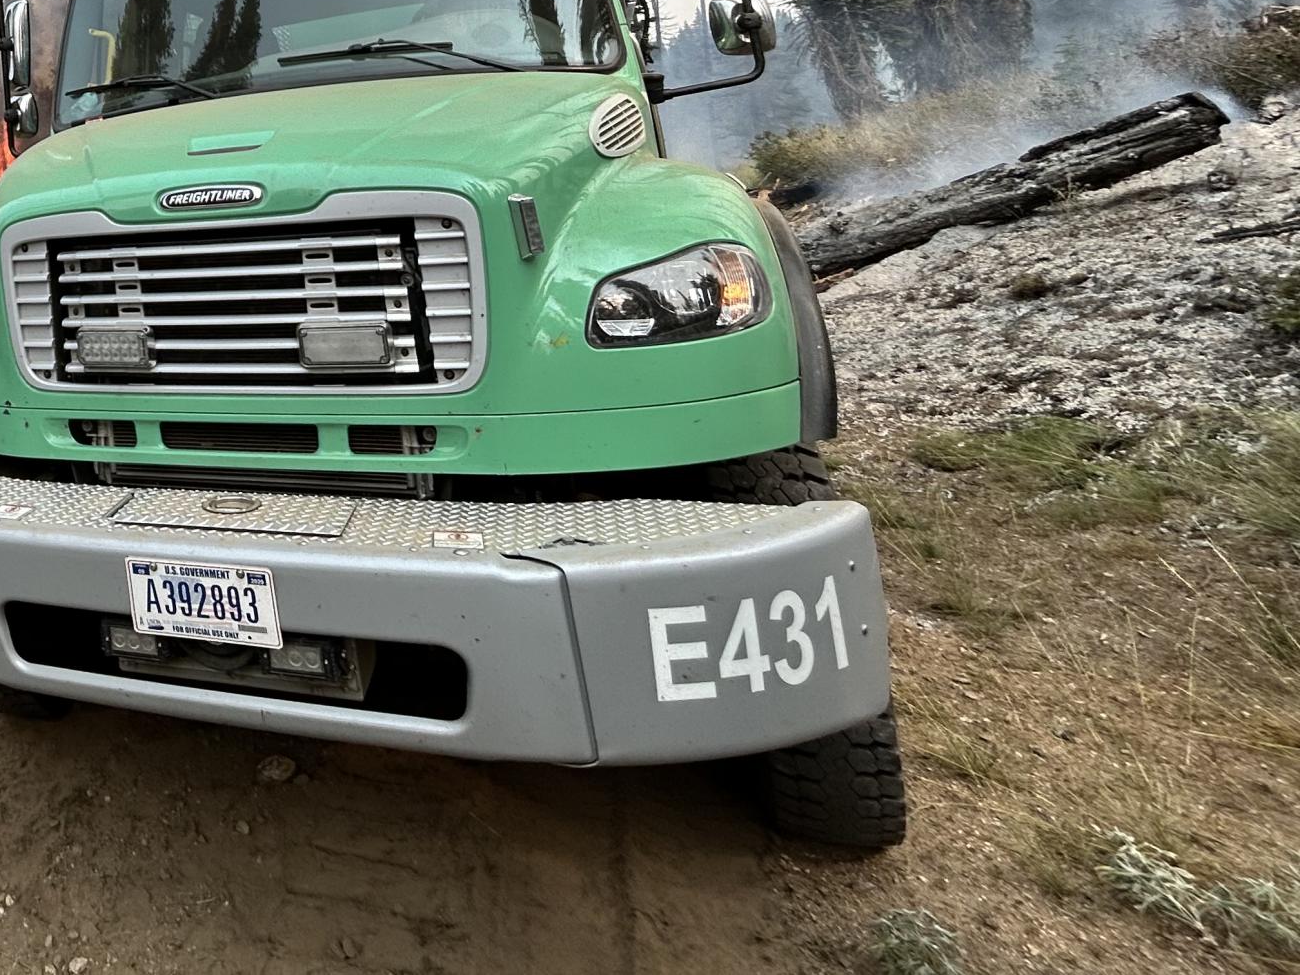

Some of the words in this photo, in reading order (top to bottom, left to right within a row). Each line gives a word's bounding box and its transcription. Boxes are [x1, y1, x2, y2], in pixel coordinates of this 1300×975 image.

[168, 189, 250, 205] FREIGHTLINER
[164, 565, 179, 575] U.S.
[179, 566, 230, 579] GOVERNMENT
[147, 578, 259, 624] A392893
[172, 625, 185, 633] FOR
[185, 627, 211, 636] OFFICIAL
[211, 629, 224, 638] USE
[224, 631, 239, 640] ONLY
[648, 575, 849, 702] E431
